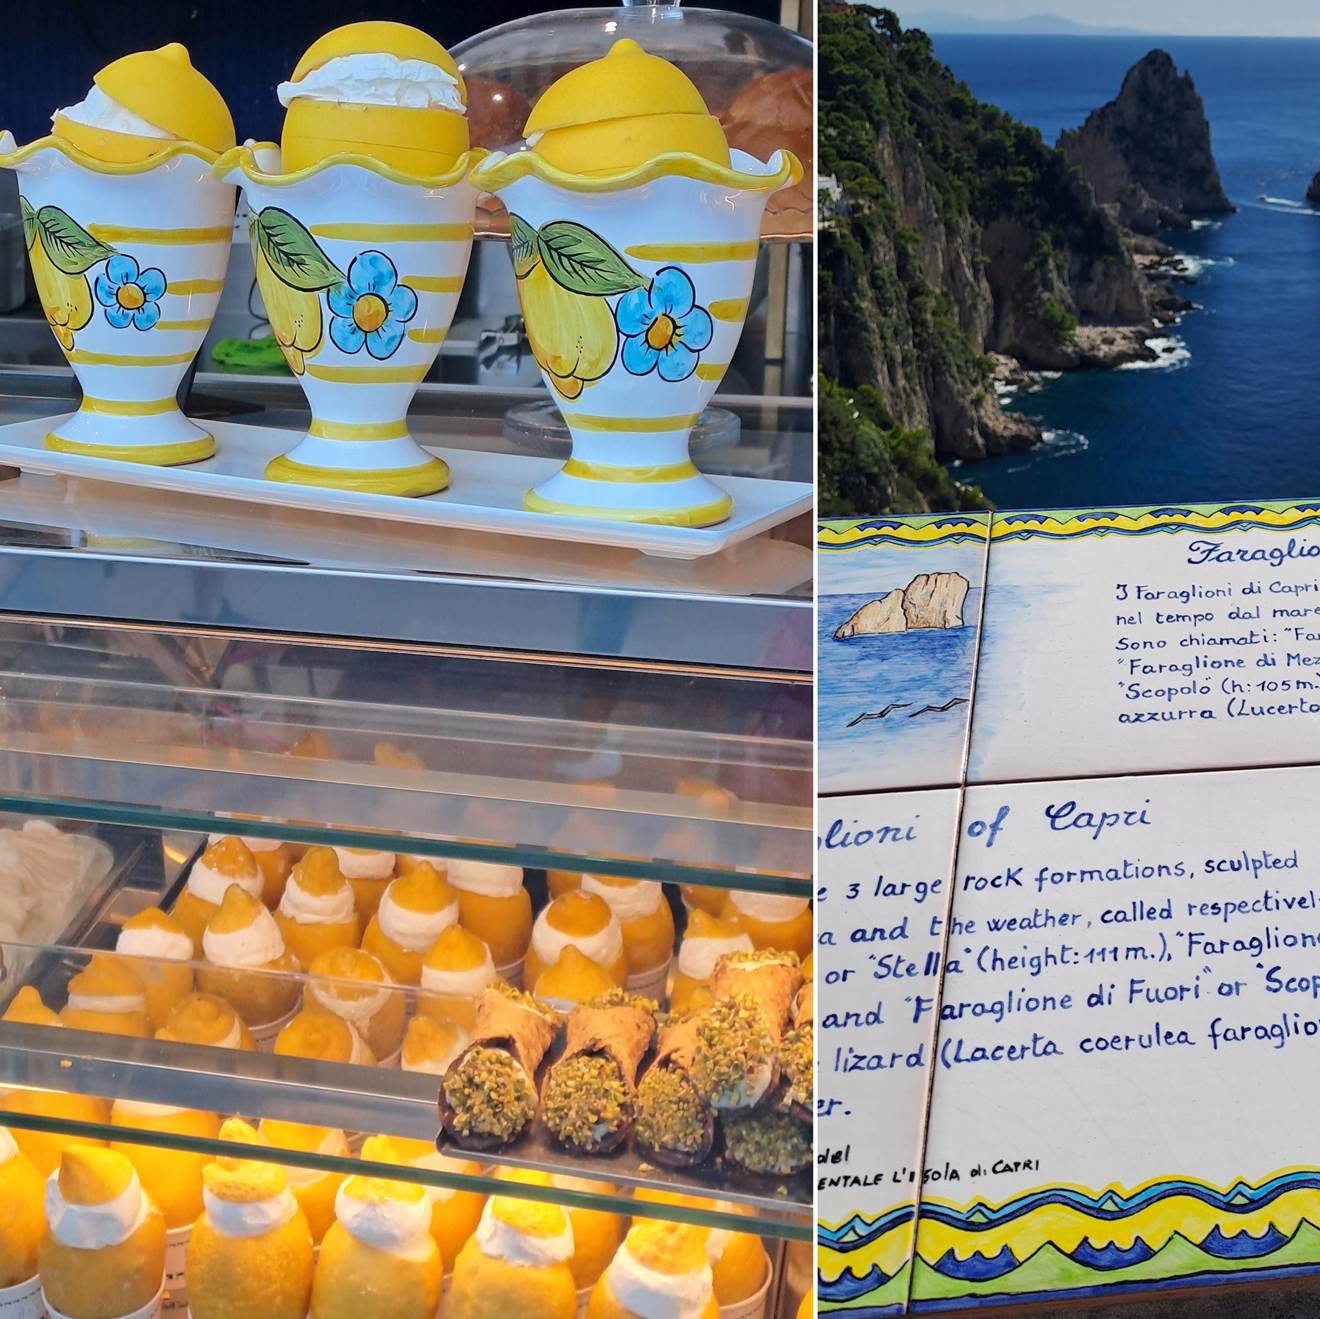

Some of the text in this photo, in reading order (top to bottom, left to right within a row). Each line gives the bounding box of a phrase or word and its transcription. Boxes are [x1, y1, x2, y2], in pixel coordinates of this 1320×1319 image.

[1136, 583, 1232, 604] Faraglioni
[1242, 581, 1261, 595] di
[1269, 579, 1318, 597] Capri
[1116, 611, 1142, 625] nel
[1156, 611, 1214, 627] tempo
[1228, 606, 1260, 620] dal
[1115, 638, 1167, 651] Sono
[1180, 630, 1278, 647] chiamati:
[1256, 652, 1276, 667] di
[1118, 708, 1217, 724] azzurra
[818, 800, 1152, 849] lioni of Capri
[846, 882, 860, 899] 3
[874, 875, 943, 903] large
[1034, 858, 1195, 892] formations,
[1204, 849, 1299, 879] sculpted
[850, 916, 909, 943] and
[929, 915, 976, 937] the
[987, 907, 1092, 932] weather,
[1101, 899, 1173, 925] called
[825, 969, 855, 985] or
[821, 1001, 885, 1029] and
[1086, 983, 1115, 1008] di
[1217, 979, 1248, 997] or
[834, 1043, 925, 1073] lizard
[940, 1033, 1064, 1069] (Lacerta
[1079, 1022, 1196, 1054] coerulea
[991, 1159, 1039, 1175] CAPRI
